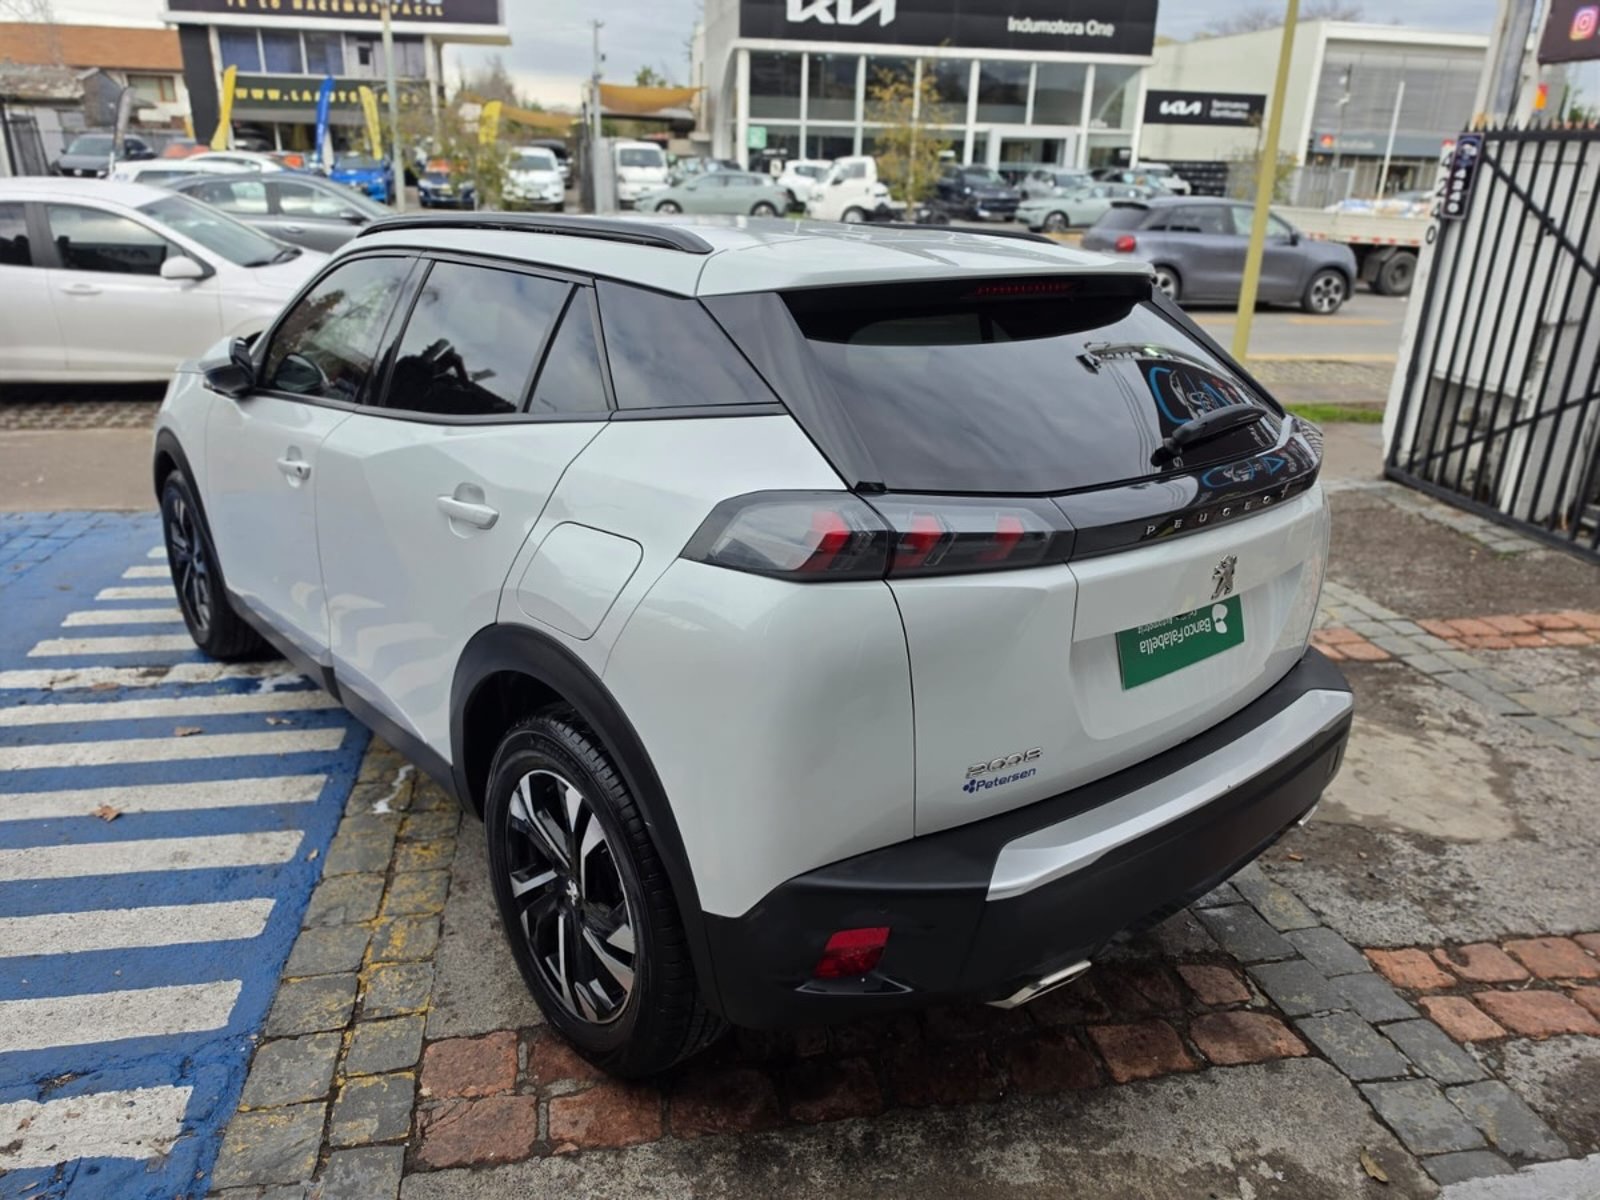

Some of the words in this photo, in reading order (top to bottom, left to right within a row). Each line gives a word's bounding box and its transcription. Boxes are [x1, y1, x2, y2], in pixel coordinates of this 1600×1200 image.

[786, 0, 897, 27] KIA
[1007, 16, 1084, 35] Indumotora
[1086, 19, 1115, 37] One
[1160, 100, 1203, 116] KIA
[1146, 482, 1291, 536] PEUGEOT
[1183, 617, 1212, 637] Banco
[1139, 629, 1184, 655] Falabella
[975, 767, 1037, 792] Petersen
